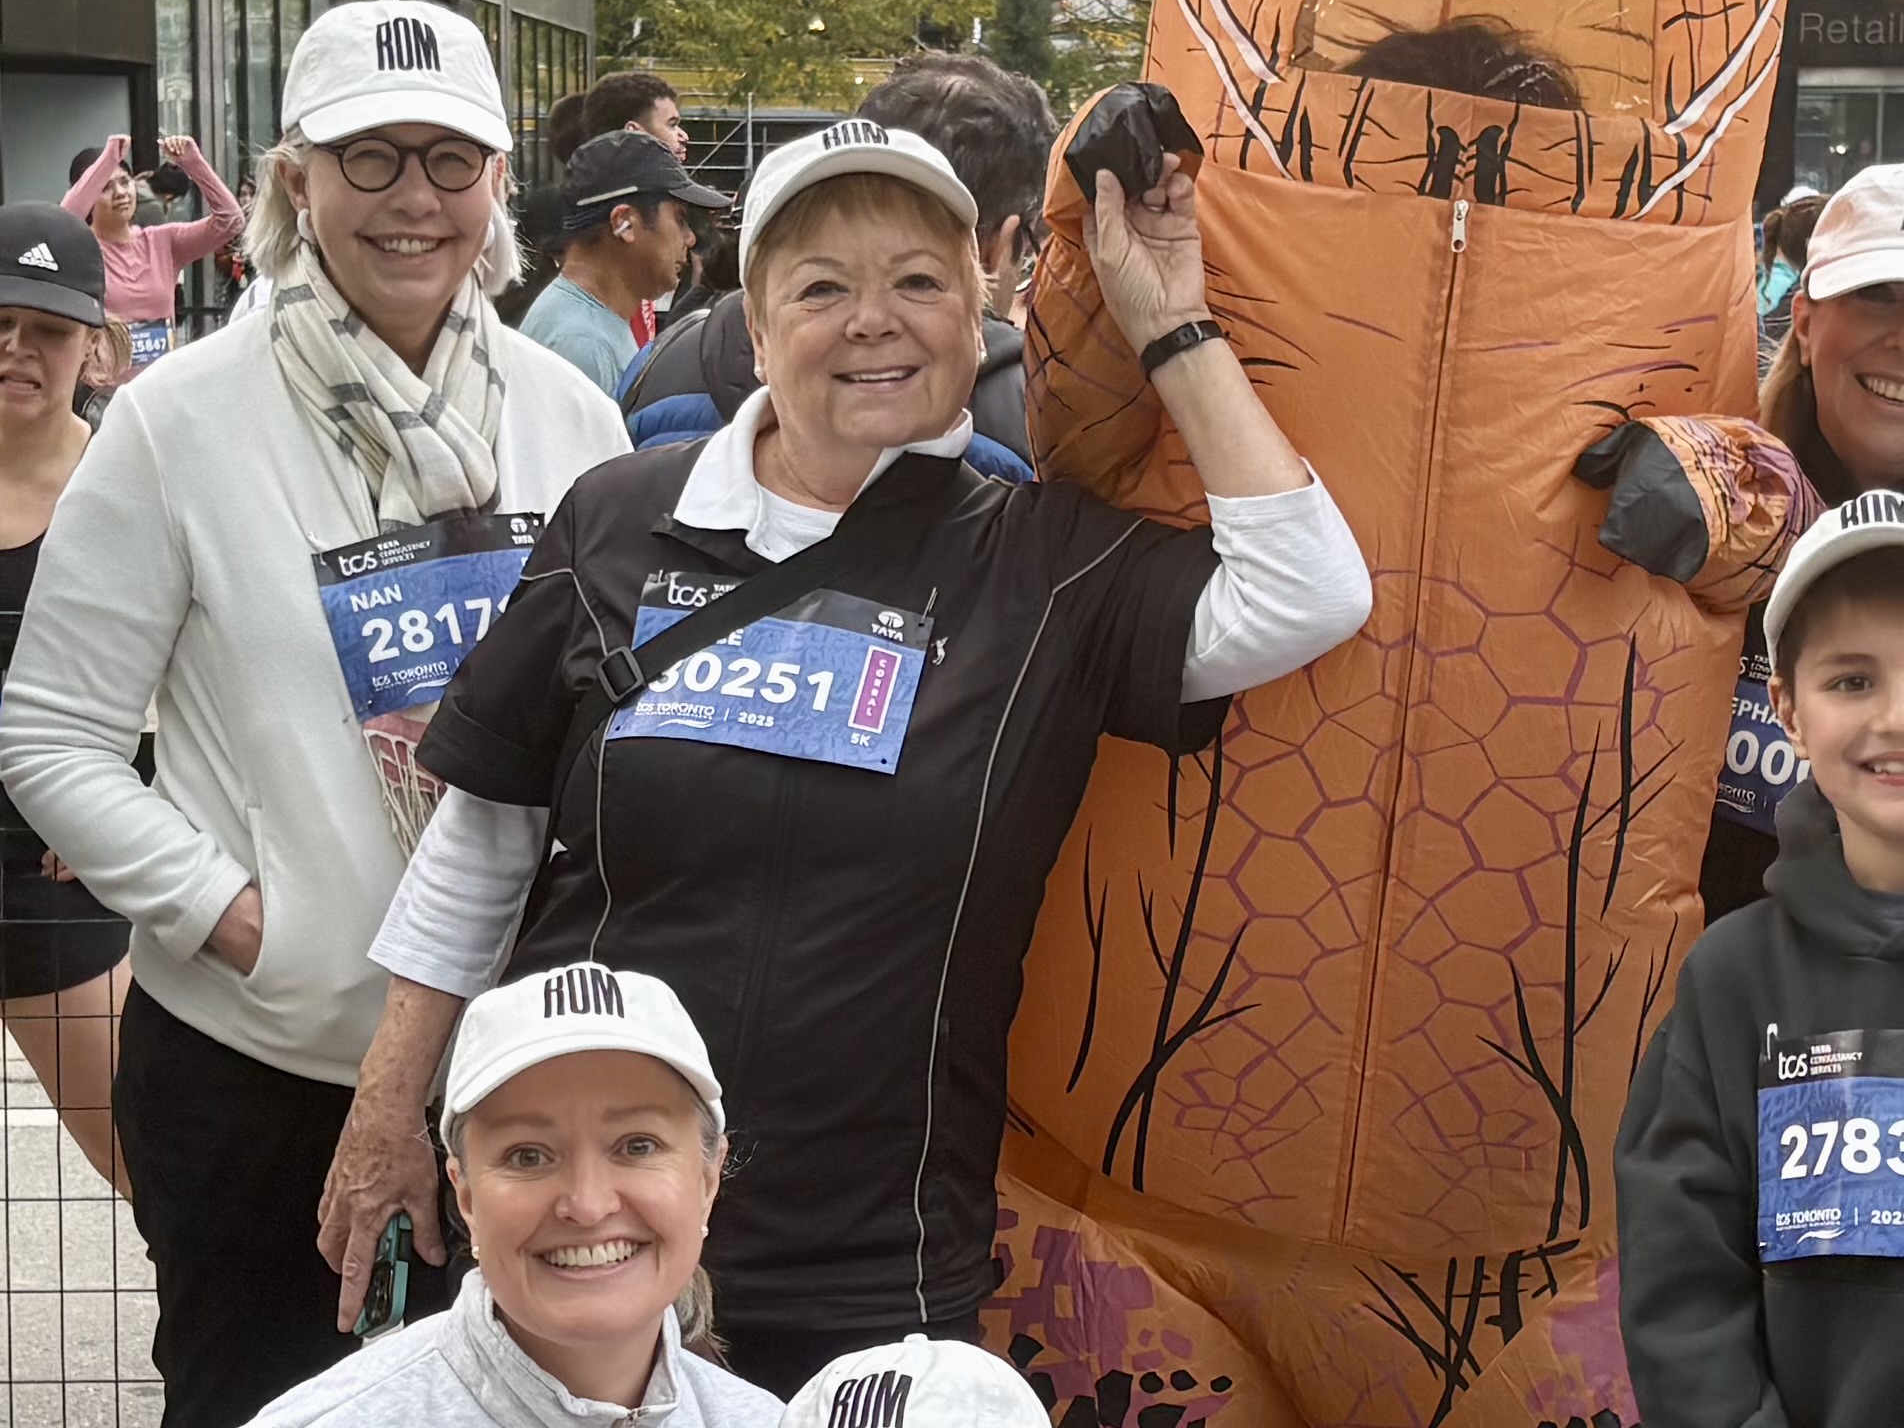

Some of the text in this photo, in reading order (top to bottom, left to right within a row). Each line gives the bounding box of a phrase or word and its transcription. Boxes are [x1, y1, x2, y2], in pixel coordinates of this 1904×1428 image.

[1798, 11, 1904, 45] Retail
[375, 16, 442, 72] ROM
[338, 550, 378, 577] tcs
[349, 583, 404, 613] NAN
[667, 578, 708, 608] tcs
[361, 594, 511, 664] 2817
[870, 623, 904, 642] TATA
[392, 660, 448, 683] TORONTO
[866, 659, 888, 718] CORRAL
[656, 702, 715, 716] TORONTO
[738, 711, 775, 728] 2025
[850, 732, 872, 747] 5K
[543, 967, 625, 1019] ROM
[1778, 1051, 1808, 1080] tcs
[1793, 1207, 1842, 1226] TORONTO
